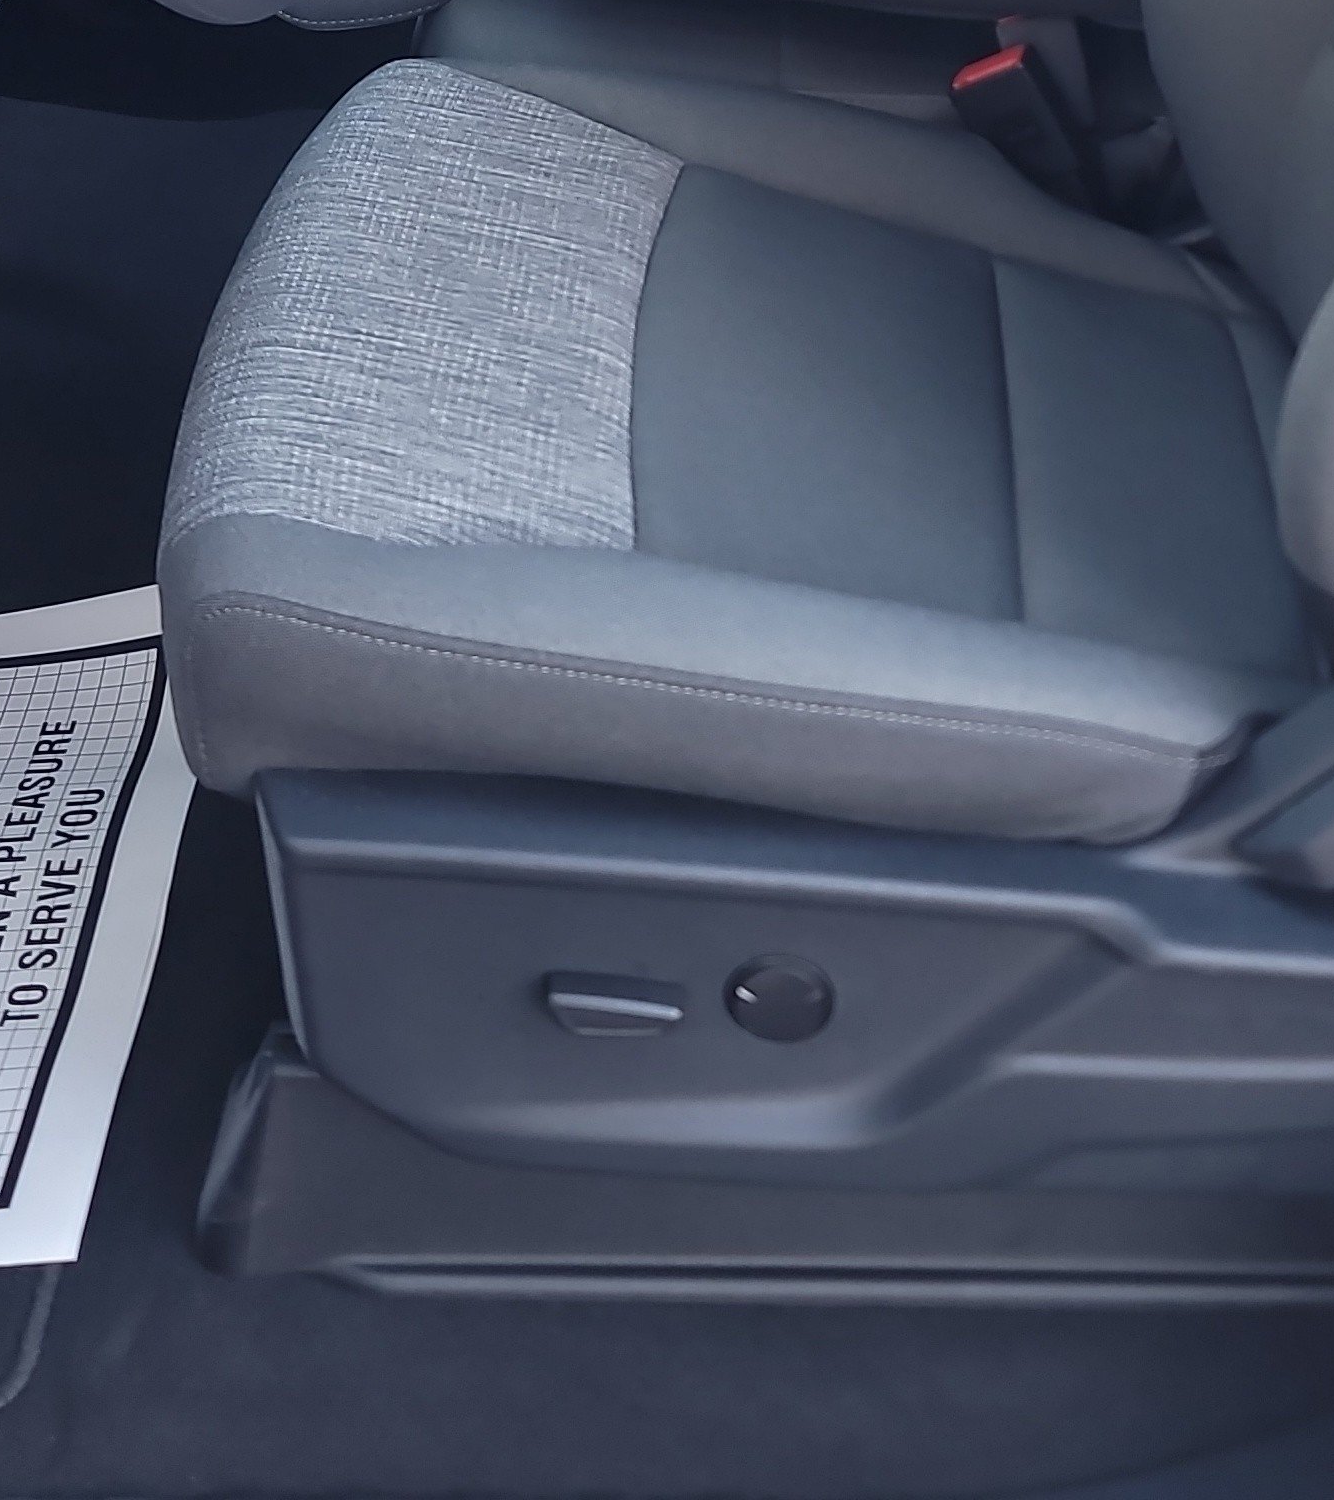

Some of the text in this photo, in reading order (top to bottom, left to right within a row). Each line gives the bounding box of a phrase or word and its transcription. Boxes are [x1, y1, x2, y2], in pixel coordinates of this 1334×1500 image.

[0, 788, 106, 1027] TO SERVE YOU
